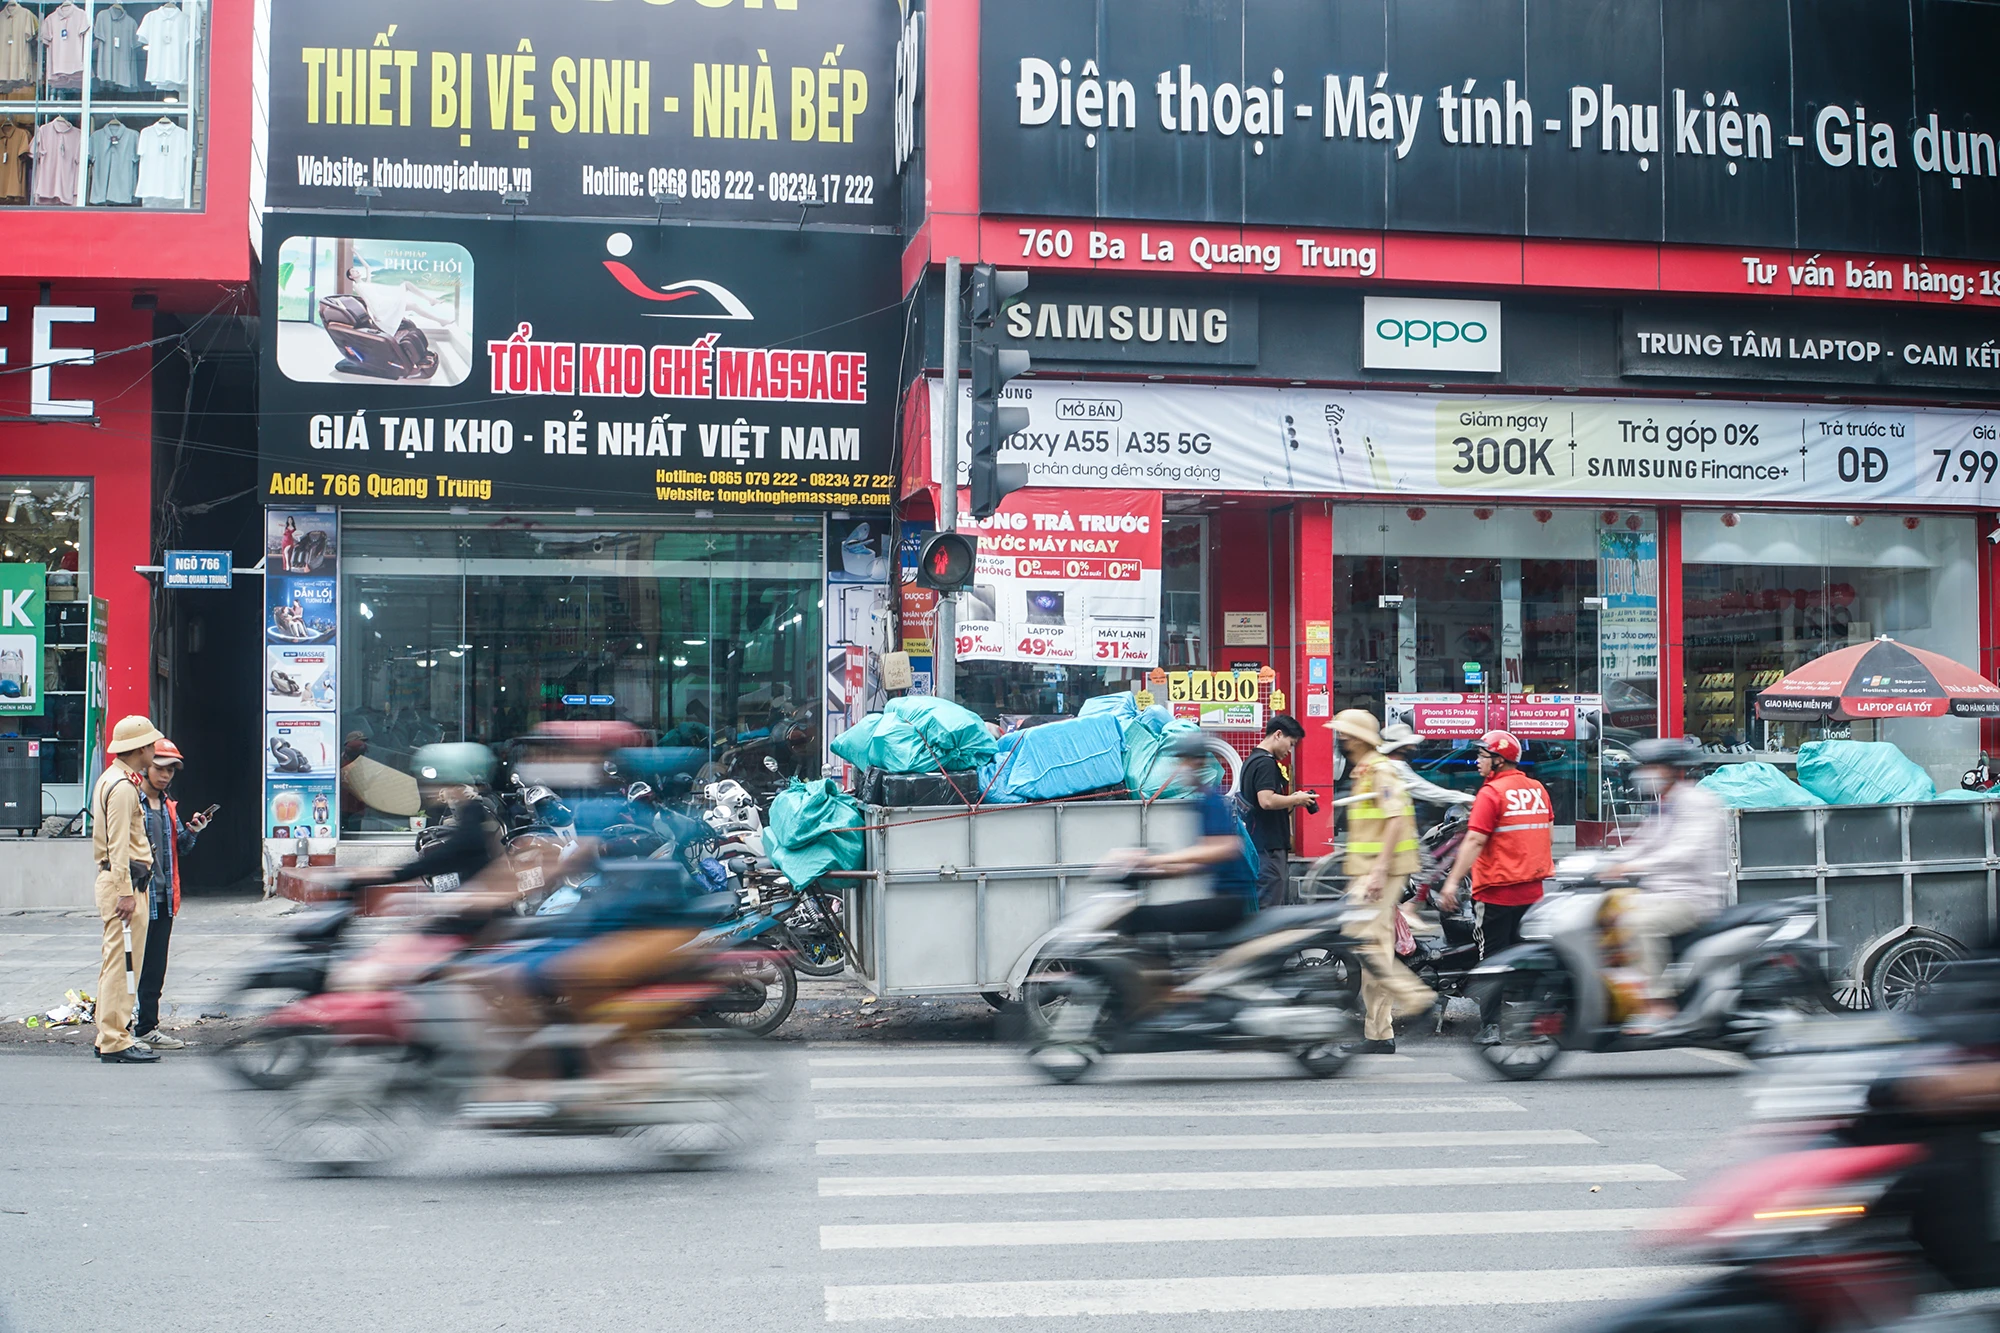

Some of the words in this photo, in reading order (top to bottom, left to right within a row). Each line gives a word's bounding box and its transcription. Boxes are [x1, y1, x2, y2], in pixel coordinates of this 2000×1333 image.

[302, 24, 417, 127] THIẾT
[431, 50, 472, 148] BỊ
[486, 38, 536, 149] VỆ
[550, 56, 650, 136] SINH
[692, 48, 779, 141] NHÀ
[791, 43, 868, 144] BẾP
[1016, 57, 1136, 149] Điện
[1156, 64, 1284, 156] thoại
[1324, 72, 1424, 160] Máy
[1438, 79, 1532, 147] tính
[1570, 84, 1658, 172] Phụ
[1672, 88, 1772, 176] kiện
[1816, 100, 1897, 168] Gia
[1912, 113, 2000, 190] dụn
[298, 155, 368, 186] Website:
[373, 157, 531, 195] khobuongiadung.vn
[582, 165, 643, 197] Hotline:
[649, 167, 687, 198] 0868
[691, 169, 720, 199] 058
[725, 170, 753, 200] 222
[769, 172, 817, 202] 08234
[822, 174, 841, 203] 17
[845, 175, 874, 204] 222
[1018, 228, 1073, 259] 760
[1089, 231, 1125, 260] Ba
[1141, 233, 1174, 262] La
[1190, 236, 1281, 272] Quang
[1297, 238, 1377, 279] Trung
[384, 258, 429, 274] PHỤC
[1742, 256, 1777, 285] Tư
[1789, 254, 1837, 292] vấn
[1846, 257, 1895, 292] bán
[1903, 262, 1974, 301] hàng:
[1007, 301, 1228, 344] SAMSUNG
[1376, 317, 1487, 349] oppo
[1637, 332, 1723, 357] TRUNG
[1729, 330, 1782, 360] TÂM
[1789, 338, 1881, 363] LAPTOP
[1903, 343, 1958, 368] CAM
[1966, 339, 2000, 369] KẾT
[487, 321, 574, 394] TỔNG
[580, 344, 645, 397] KHO
[652, 333, 718, 400] GHẾ
[717, 349, 867, 403] MASSAGE
[1062, 401, 1085, 416] MỞ
[1089, 401, 1115, 417] BÁN
[1460, 410, 1500, 429] Giảm
[1506, 415, 1549, 432] ngay
[1819, 420, 1845, 437] Trả
[1847, 420, 1884, 438] trước
[1886, 421, 1905, 438] từ
[1973, 424, 1996, 440] Giá
[309, 409, 369, 450] GIÁ
[380, 417, 434, 458] TẠI
[444, 419, 513, 454] KHO
[545, 409, 587, 456] RẺ
[598, 413, 687, 457] NHẤT
[699, 417, 769, 465] VIỆT
[781, 426, 860, 461] NAM
[1064, 431, 1109, 452] A55
[1125, 431, 1170, 454] A35
[1178, 432, 1212, 455] 5G
[1618, 420, 1660, 445] Trả
[1666, 419, 1718, 453] góp
[1723, 423, 1759, 447] 0%
[1452, 436, 1555, 477] 300K
[1838, 444, 1888, 484] 0Đ
[656, 469, 707, 485] Hotline:
[709, 470, 742, 485] 0865
[745, 472, 770, 486] 079
[773, 473, 798, 487] 222
[810, 473, 849, 488] 08234
[853, 474, 869, 488] 27
[1034, 462, 1068, 475] chân
[1072, 463, 1107, 479] dung
[1111, 464, 1143, 477] đêm
[1147, 461, 1181, 480] sống
[1184, 463, 1220, 480] động
[1587, 457, 1697, 479] SAMSUNG
[1702, 460, 1790, 481] Finance+
[269, 472, 314, 495] Add:
[321, 474, 360, 496] 766
[367, 474, 428, 499] Quang
[436, 475, 492, 500] Trung
[656, 487, 714, 501] Website:
[717, 489, 890, 506] tongkhoghemassage.com
[1033, 510, 1075, 531] TRẢ
[1079, 512, 1149, 534] TRƯỚC
[1029, 535, 1068, 552] MÁY
[1070, 540, 1119, 554] NGAY
[175, 555, 198, 570] NGÕ
[200, 558, 220, 570] 766
[975, 565, 1011, 577] KHÔNG
[989, 557, 1004, 565] GÓP
[189, 575, 208, 584] QUANG
[208, 575, 227, 584] TRUNG
[1027, 627, 1064, 636] LAPTOP
[1098, 629, 1118, 638] MÁY
[1120, 631, 1146, 641] LẠNH
[1018, 638, 1046, 655] 49
[1096, 641, 1119, 659] 31
[1534, 709, 1544, 717] CŨ
[1560, 708, 1569, 717] #1
[1765, 699, 1781, 708] GIAO
[1783, 699, 1802, 709] HÀNG
[1803, 699, 1820, 709] MIỄN
[1821, 701, 1832, 709] PHÍ
[1857, 703, 1893, 712] LAPTOP
[1895, 702, 1912, 711] GIÁ
[1914, 701, 1932, 712] TỐT
[1956, 704, 1970, 712] GIAO
[1970, 703, 1985, 712] HÀNG
[1505, 788, 1546, 812] SPX
